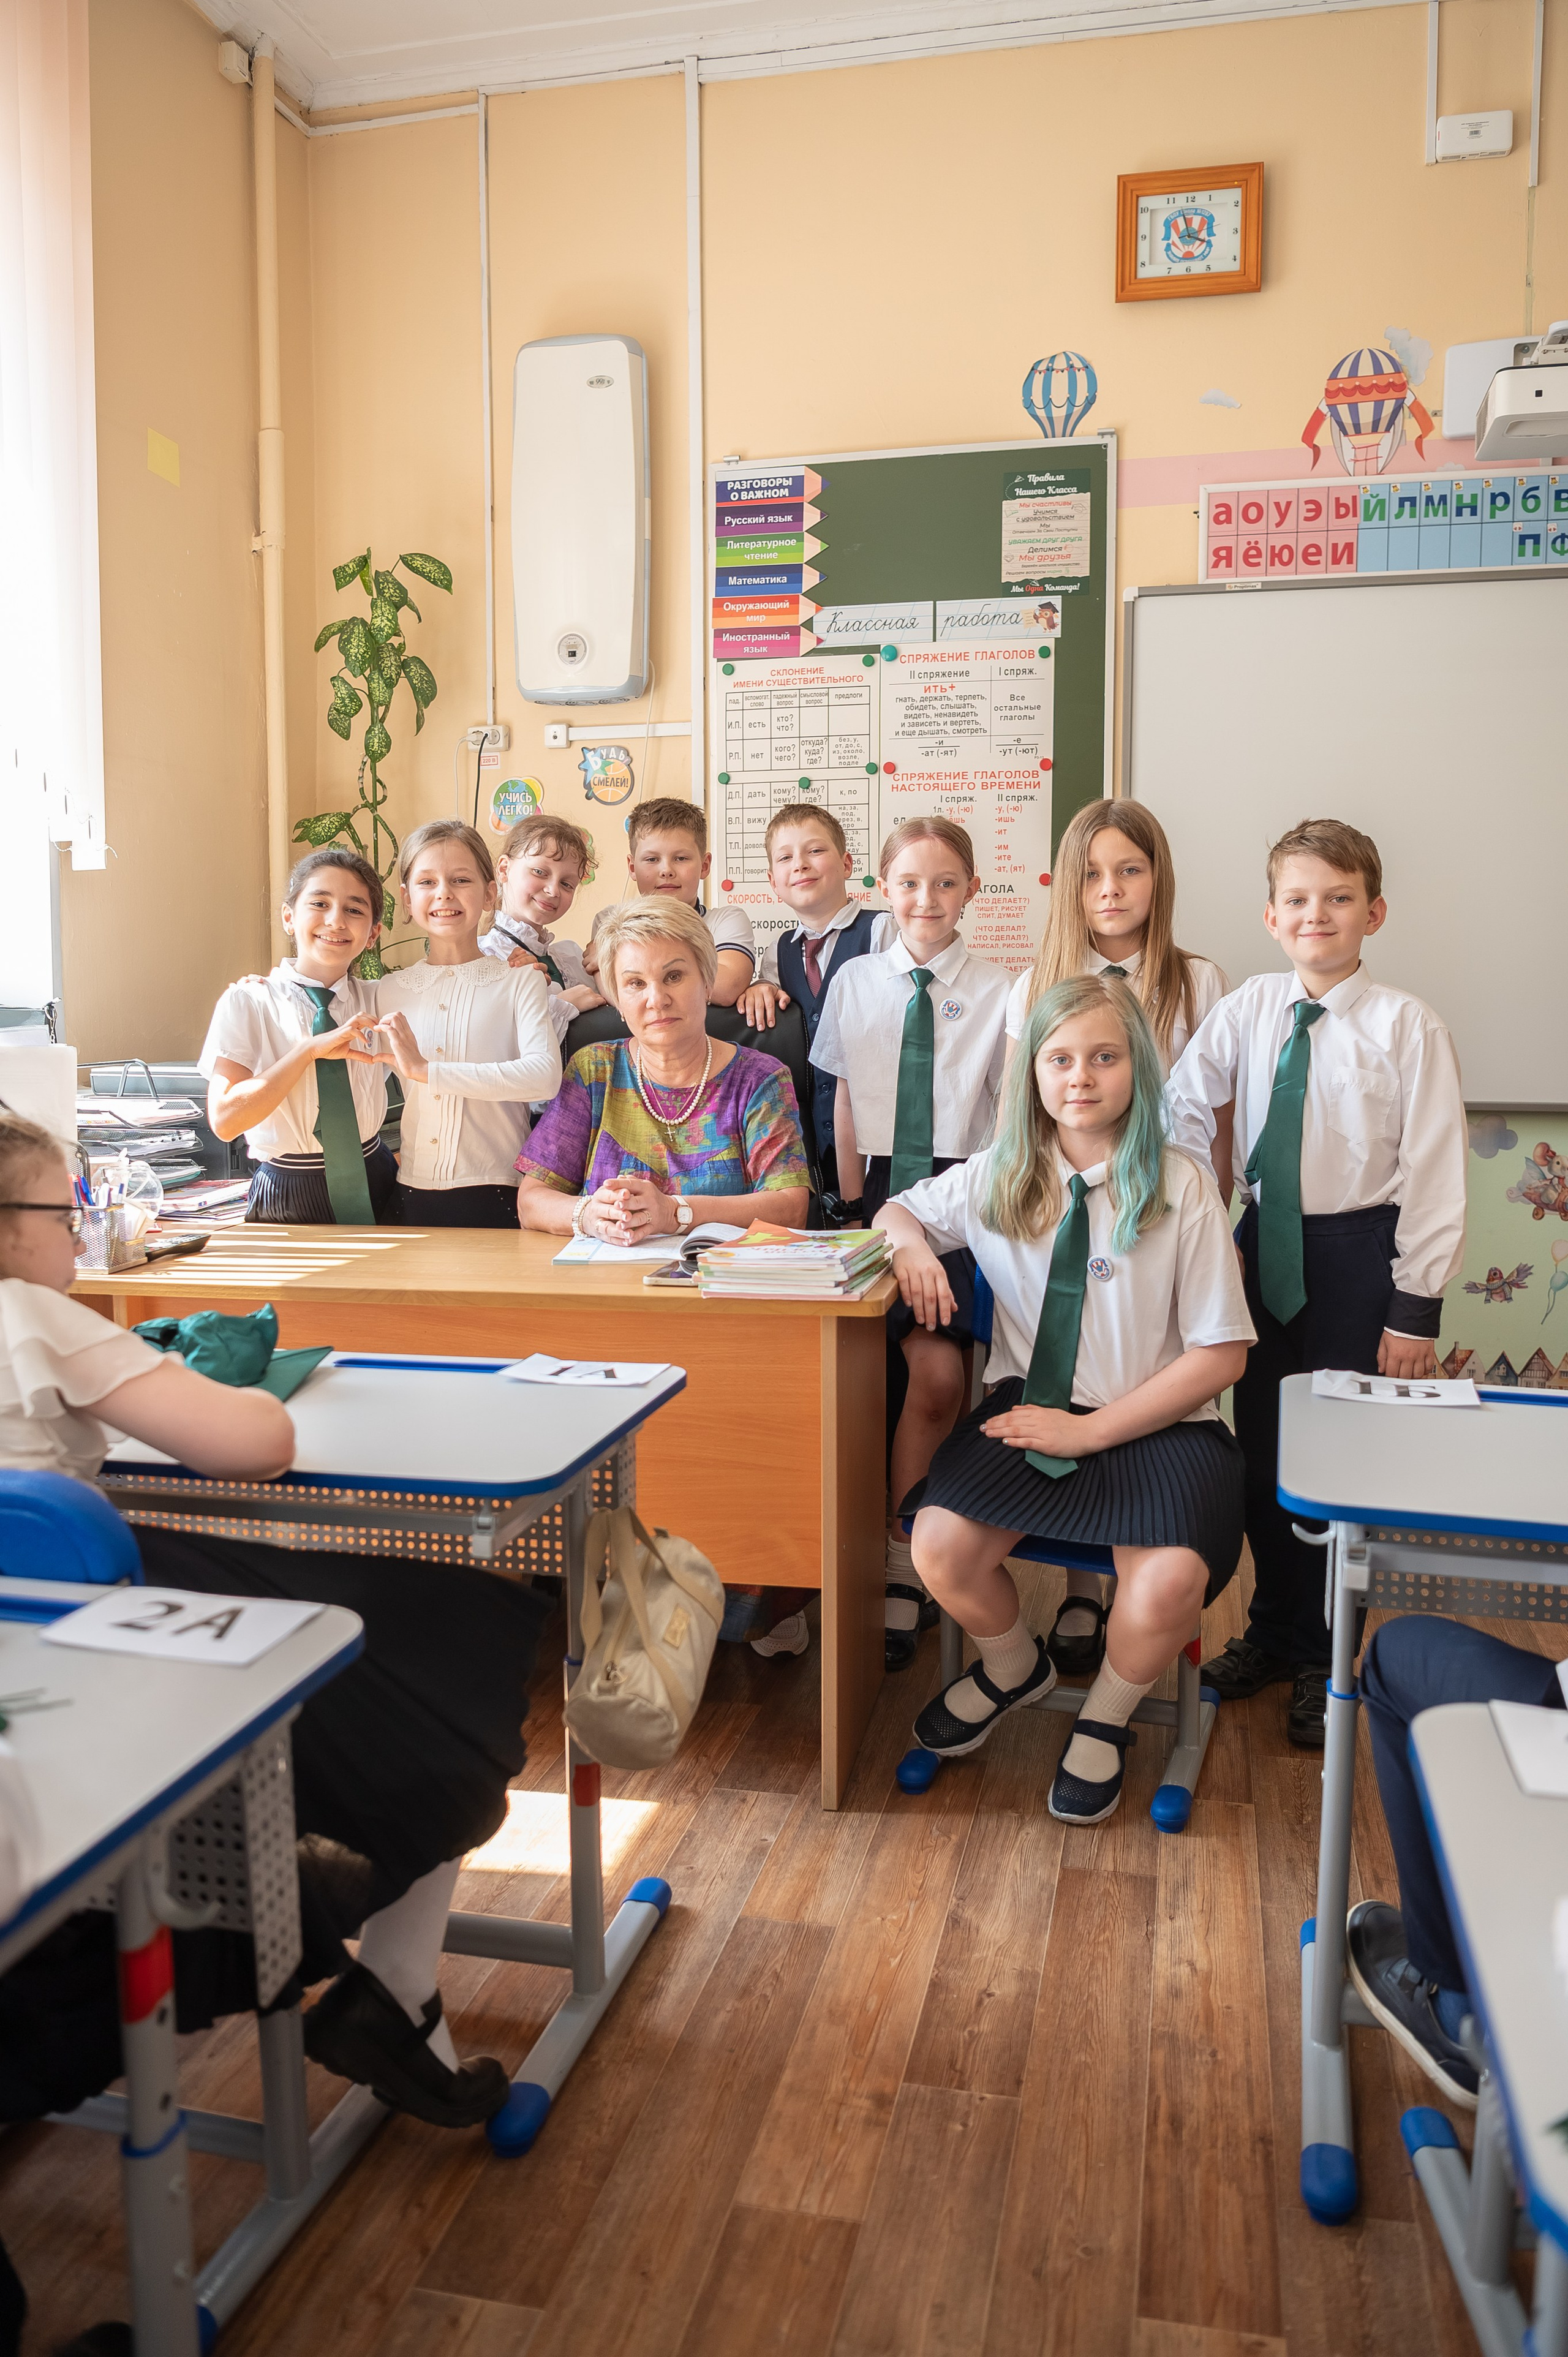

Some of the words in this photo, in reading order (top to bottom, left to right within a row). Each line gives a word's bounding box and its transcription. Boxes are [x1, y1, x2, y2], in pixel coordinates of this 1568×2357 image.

[727, 477, 792, 490] РАЗГОВОРЫ
[1027, 473, 1065, 485] Правила
[730, 492, 739, 500] О
[741, 488, 789, 500] ВАЖНОМ
[1212, 503, 1232, 525] а
[1242, 502, 1264, 524] о
[1273, 500, 1292, 528] у
[1303, 499, 1322, 521] э
[1335, 496, 1357, 519] ы
[1363, 494, 1386, 521] й
[1394, 496, 1417, 519] л
[1424, 494, 1448, 518] м
[1455, 494, 1478, 517] н
[1490, 491, 1510, 519] р
[1521, 486, 1541, 513] б
[725, 515, 765, 527] Русский
[726, 539, 796, 550] Литературное
[1211, 546, 1232, 568] я
[1243, 540, 1262, 567] ё
[1269, 545, 1294, 567] ю
[1302, 543, 1322, 565] е
[1331, 542, 1354, 565] и
[1518, 534, 1540, 557] п
[729, 576, 787, 585] Математика
[1025, 585, 1044, 594] Одна
[1044, 583, 1080, 593] Команда!
[723, 600, 790, 612] Окружающий
[827, 611, 919, 633] Классная
[940, 603, 1023, 637] работа
[723, 632, 790, 643] Иностранный
[900, 652, 970, 664] СПРЯЖЕНИЕ
[974, 650, 1035, 660] ГЛАГОЛОВ
[771, 667, 824, 676] СКЛОНЕНИЕ
[918, 669, 970, 681] спряжение
[1004, 667, 1037, 677] спряж.
[766, 675, 864, 687] СУЩЕСТВИТЕЛЬНОГО
[956, 693, 987, 702] терпеть,
[728, 721, 741, 730] И.П.
[801, 737, 827, 747] откуда?
[805, 747, 824, 756] куда?
[937, 748, 957, 758] (-ят)
[1015, 746, 1038, 756] (-ют)
[807, 756, 822, 766] где?
[892, 772, 968, 781] СПРЯЖЕНИЕ
[974, 770, 1039, 779] ГЛАГОЛОВ
[593, 776, 628, 788] СМЕЛЕЙ!
[891, 782, 976, 793] НАСТОЯЩЕГО
[981, 782, 1041, 790] ВРЕМЕНИ
[728, 791, 742, 800] Д.П.
[774, 786, 796, 796] кому?
[802, 785, 824, 795] кому?
[499, 792, 532, 803] УЧИСЬ
[1006, 794, 1038, 803] спряж.
[498, 805, 533, 815] ЛЕГКО!
[1011, 864, 1025, 873] (ят)
[727, 894, 774, 905] СКОРОСТЬ,
